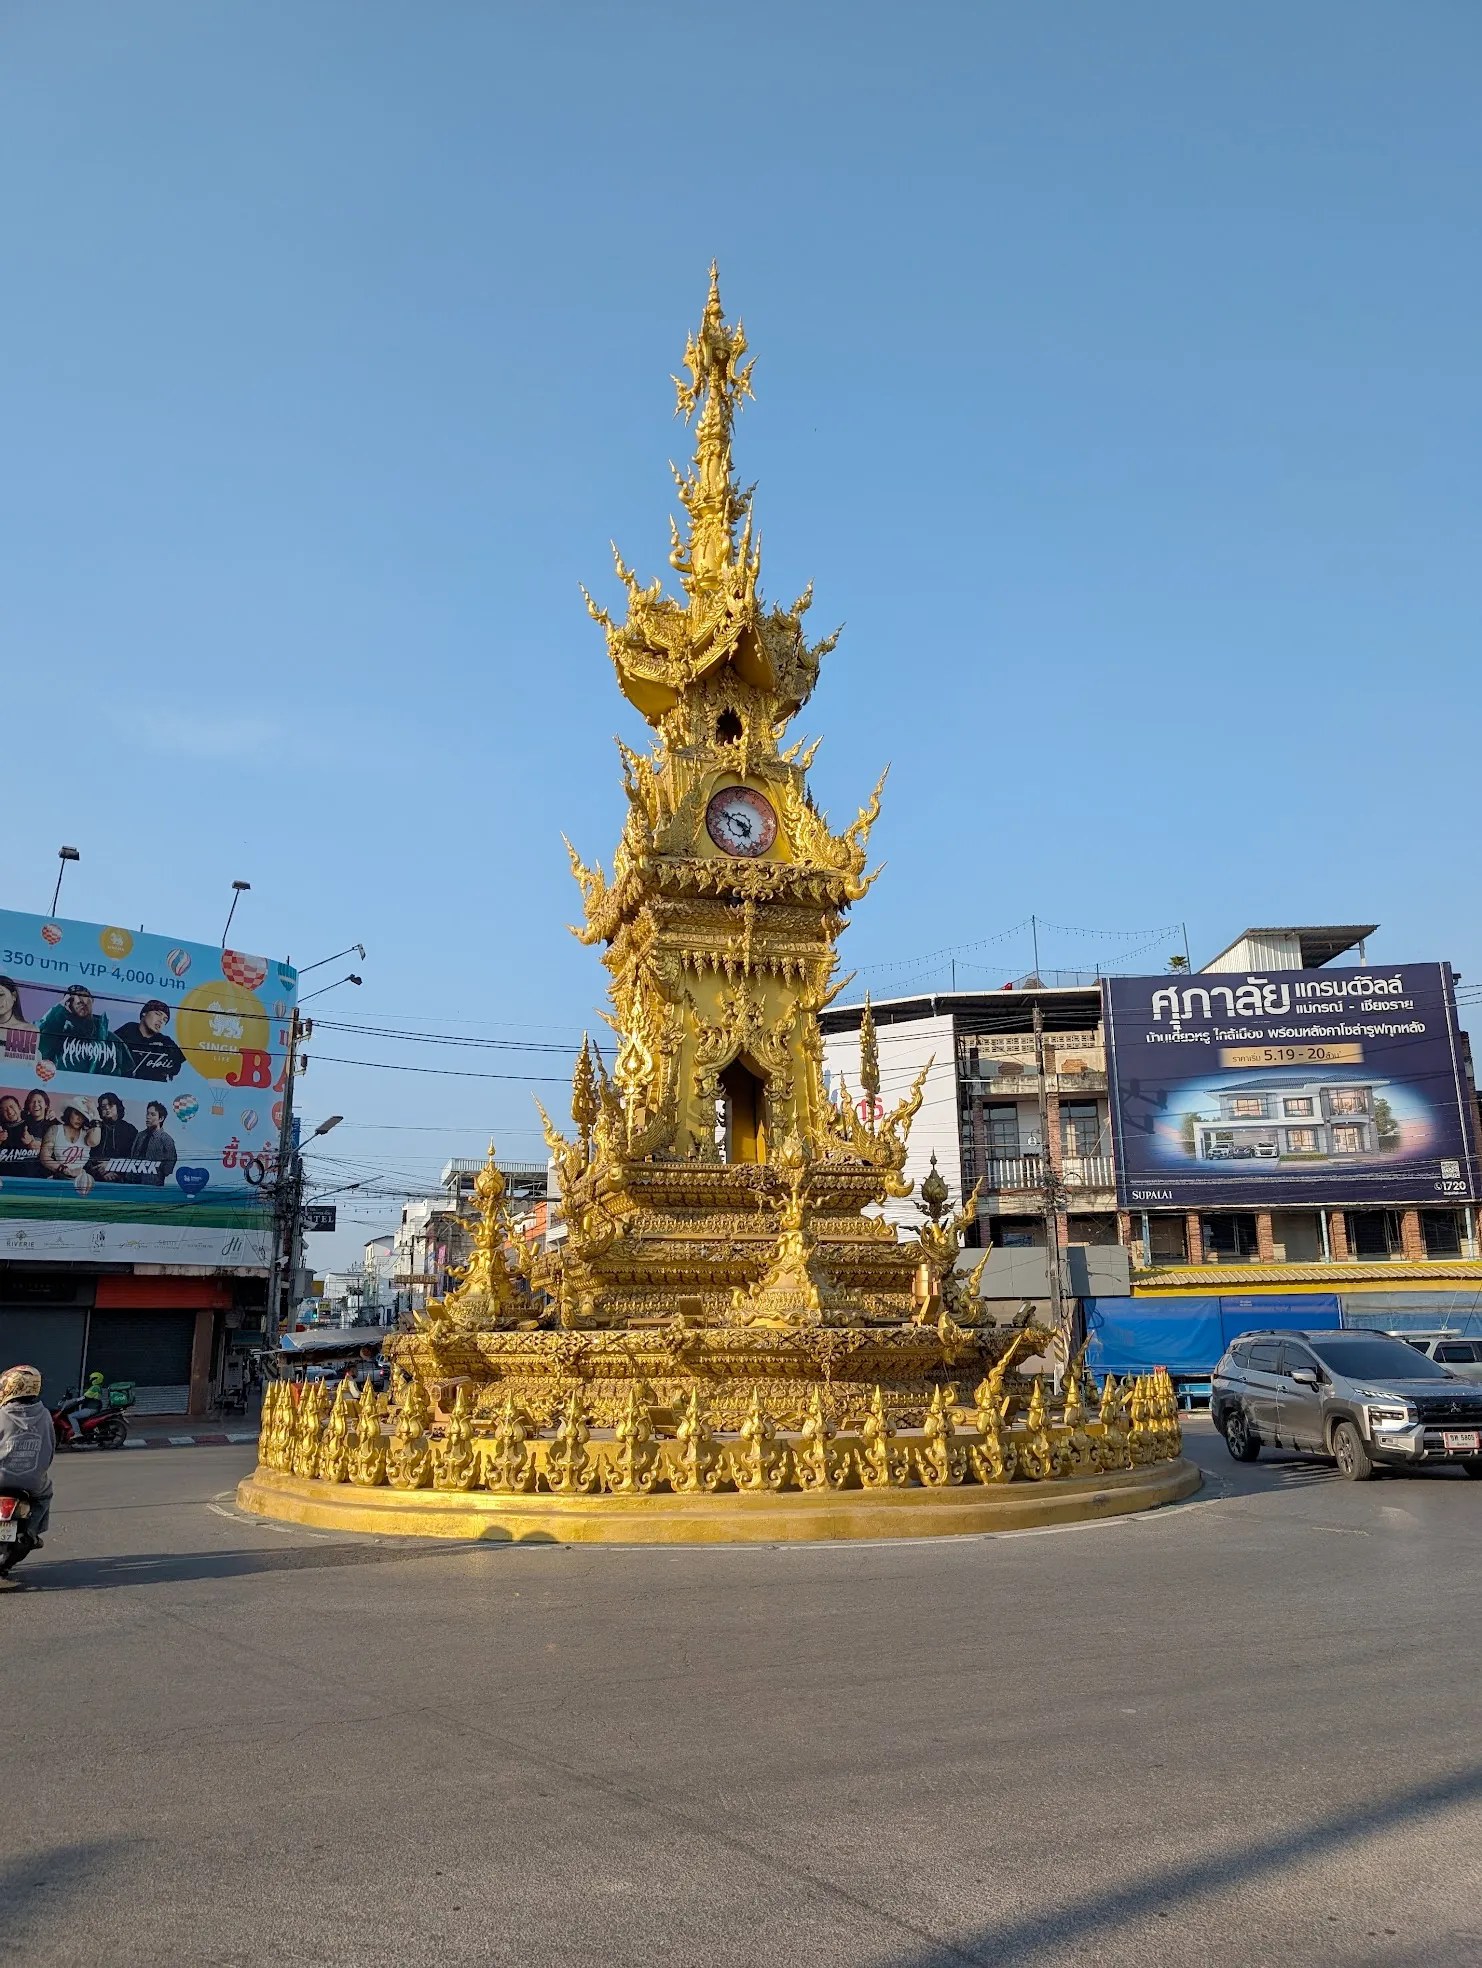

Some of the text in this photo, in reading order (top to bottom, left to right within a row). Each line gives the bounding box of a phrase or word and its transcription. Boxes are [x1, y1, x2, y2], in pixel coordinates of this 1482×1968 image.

[2, 950, 186, 990] 350 บาท VIP 4,000 บาท
[1295, 973, 1403, 998] แกรนด์วิลล์
[1151, 976, 1291, 1030] ศุภาลัย
[1296, 1000, 1343, 1014] แม่กรณ์
[1361, 999, 1414, 1012] เชียงราย
[1263, 1049, 1295, 1061] 5.19
[1442, 1181, 1467, 1191] 1720
[1132, 1190, 1172, 1200] SUPALAI
